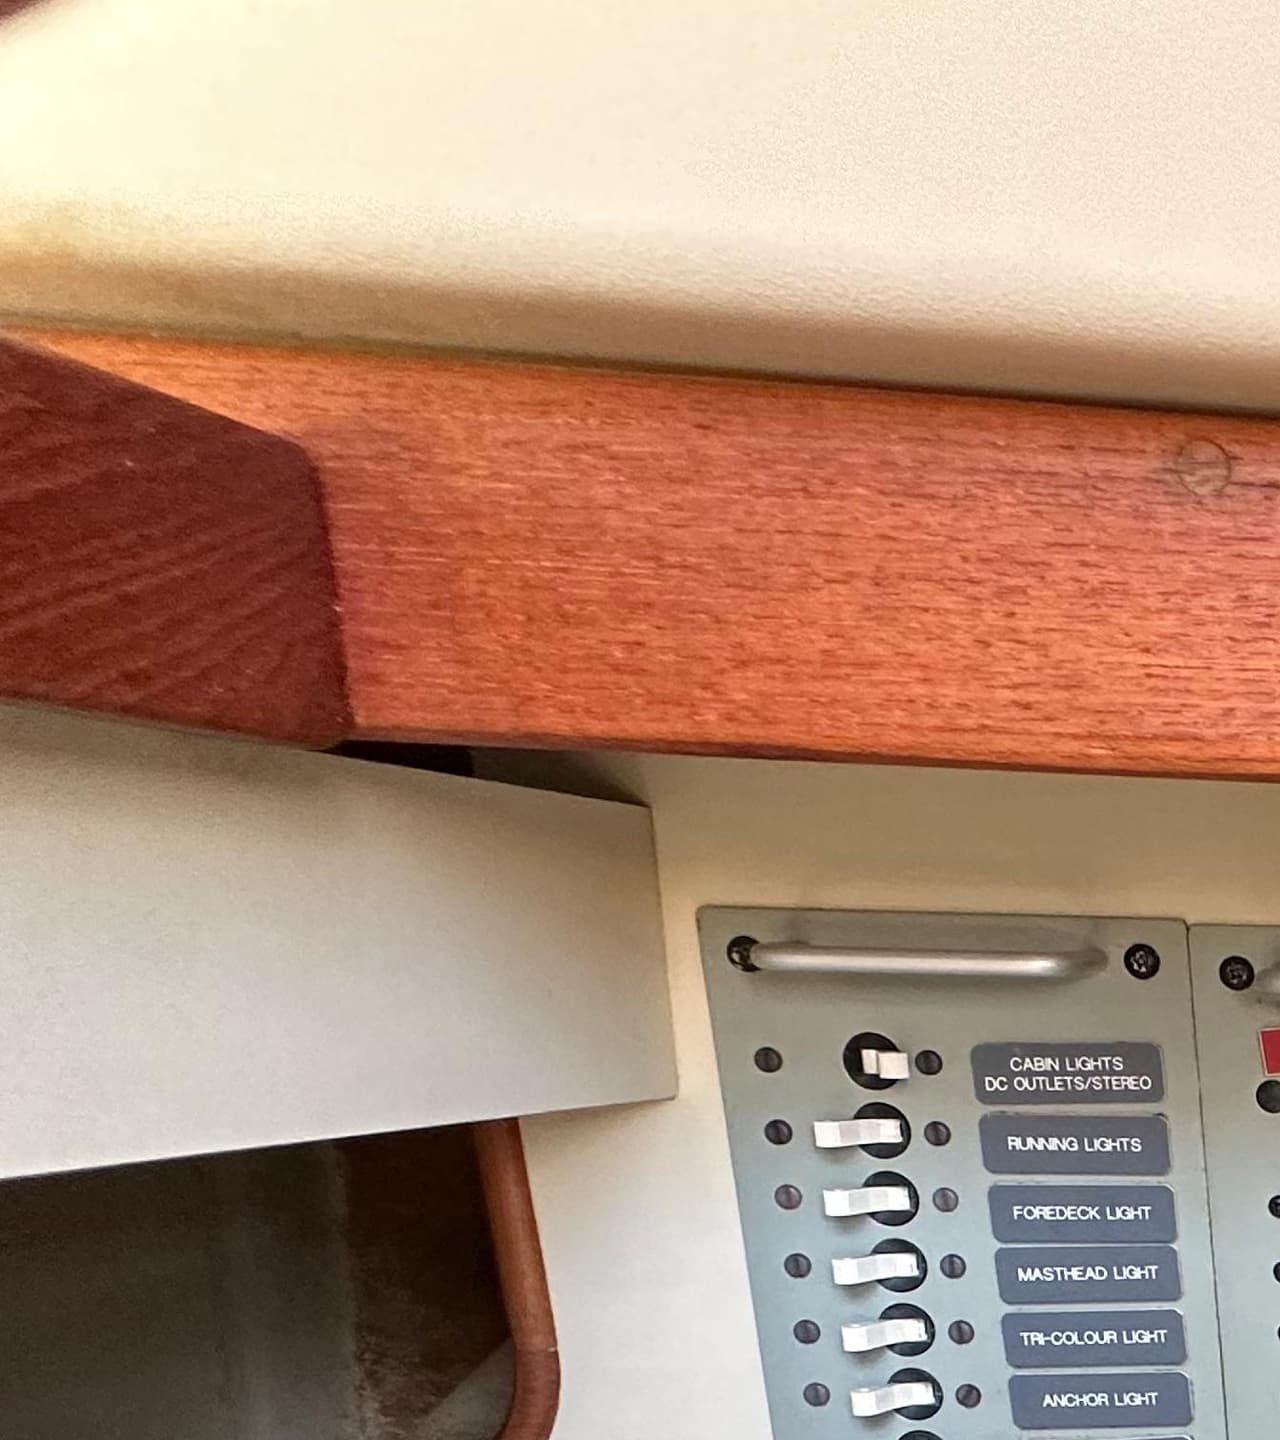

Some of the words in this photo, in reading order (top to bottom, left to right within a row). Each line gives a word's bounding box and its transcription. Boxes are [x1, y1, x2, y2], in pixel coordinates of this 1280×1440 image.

[1009, 1057, 1060, 1072] CABIN
[1065, 1056, 1124, 1071] LIGHTS
[985, 1076, 1008, 1091] DC
[1014, 1076, 1152, 1091] OUTLETS/STEREO
[1008, 1136, 1078, 1152] RUNNING
[1084, 1137, 1143, 1152] LIGHTS
[1013, 1205, 1101, 1221] FOREDECK
[1106, 1205, 1152, 1220] LIGHT
[1018, 1266, 1107, 1282] MASTHEAD
[1113, 1265, 1159, 1280] LIGHT
[1020, 1330, 1120, 1346] TRI-COLOUR
[1123, 1330, 1168, 1345] LIGHT
[1043, 1392, 1110, 1408] ANCHOR
[1113, 1392, 1159, 1407] LIGHT
